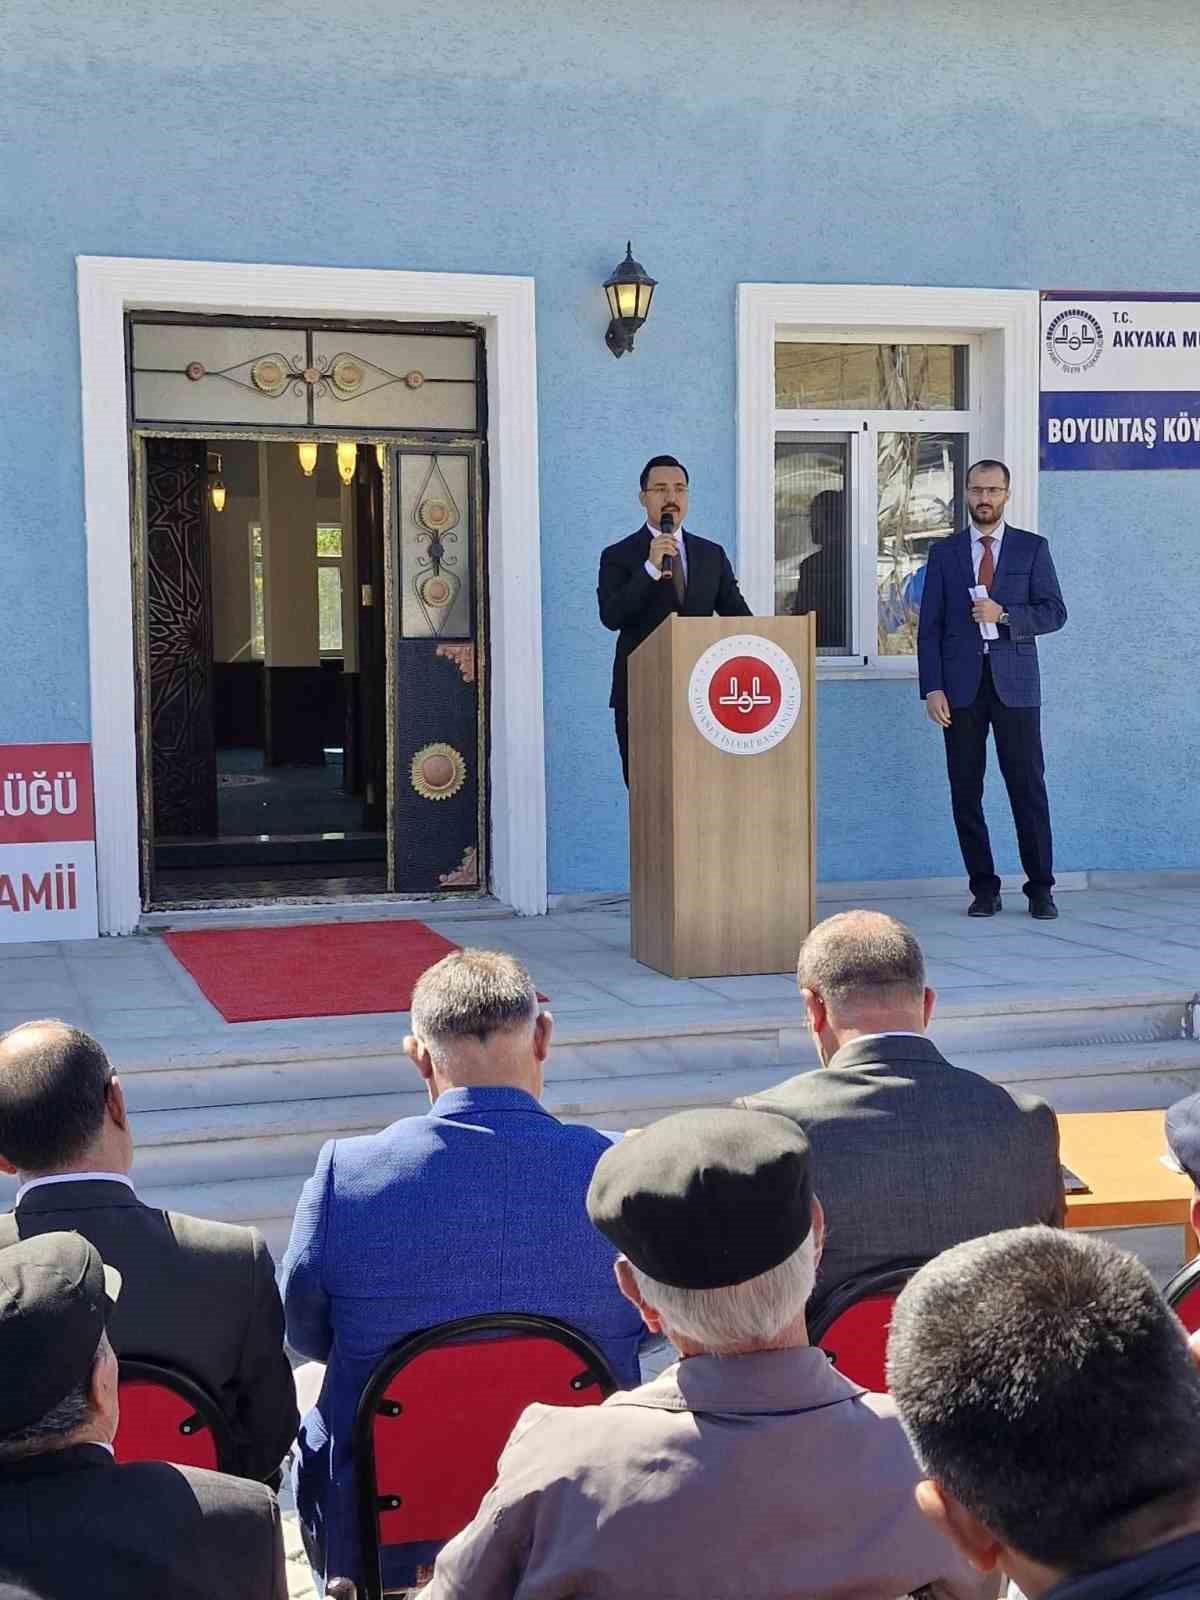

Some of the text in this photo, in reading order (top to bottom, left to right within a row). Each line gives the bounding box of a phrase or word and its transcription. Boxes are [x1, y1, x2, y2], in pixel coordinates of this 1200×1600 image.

[1112, 311, 1133, 323] T.C.
[1112, 330, 1200, 348] AKYAKA M
[1048, 418, 1156, 448] BOYUNTAŞ
[0, 771, 77, 816] ÜĞÜ
